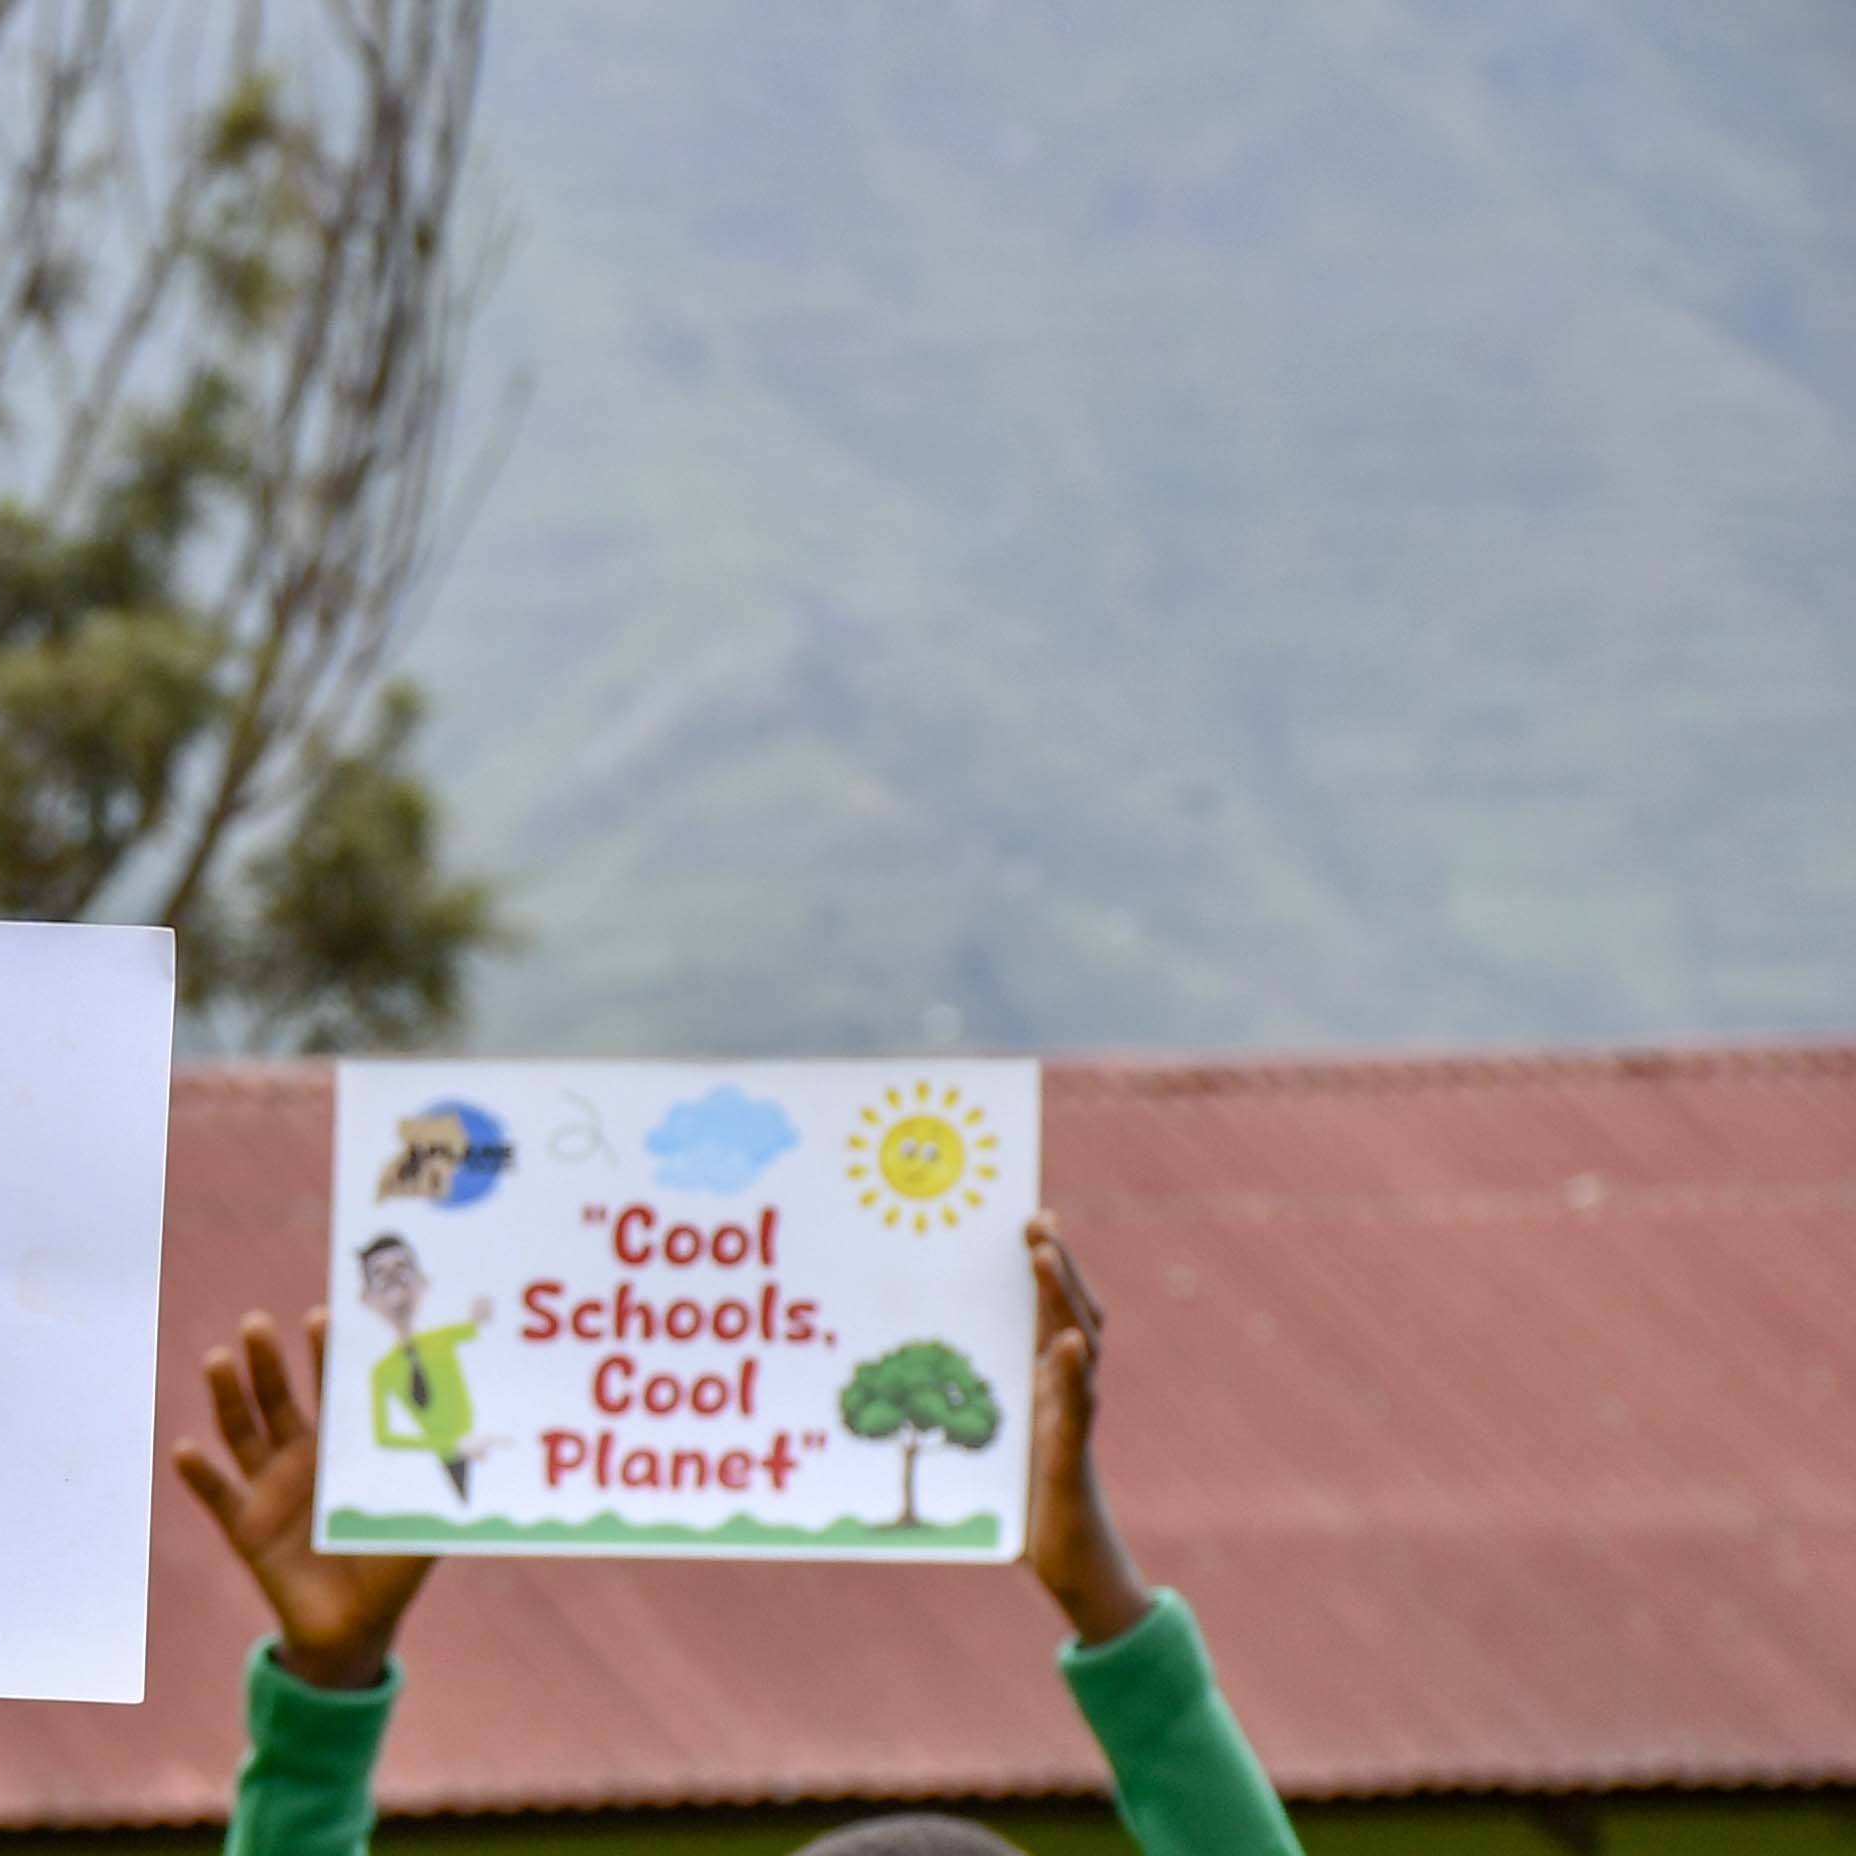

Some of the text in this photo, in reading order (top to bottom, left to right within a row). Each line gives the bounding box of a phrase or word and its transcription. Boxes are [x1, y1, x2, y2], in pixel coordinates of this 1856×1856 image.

[583, 1205, 777, 1267] "Cool
[592, 1356, 757, 1416] Cool
[539, 1429, 827, 1491] Planet"
